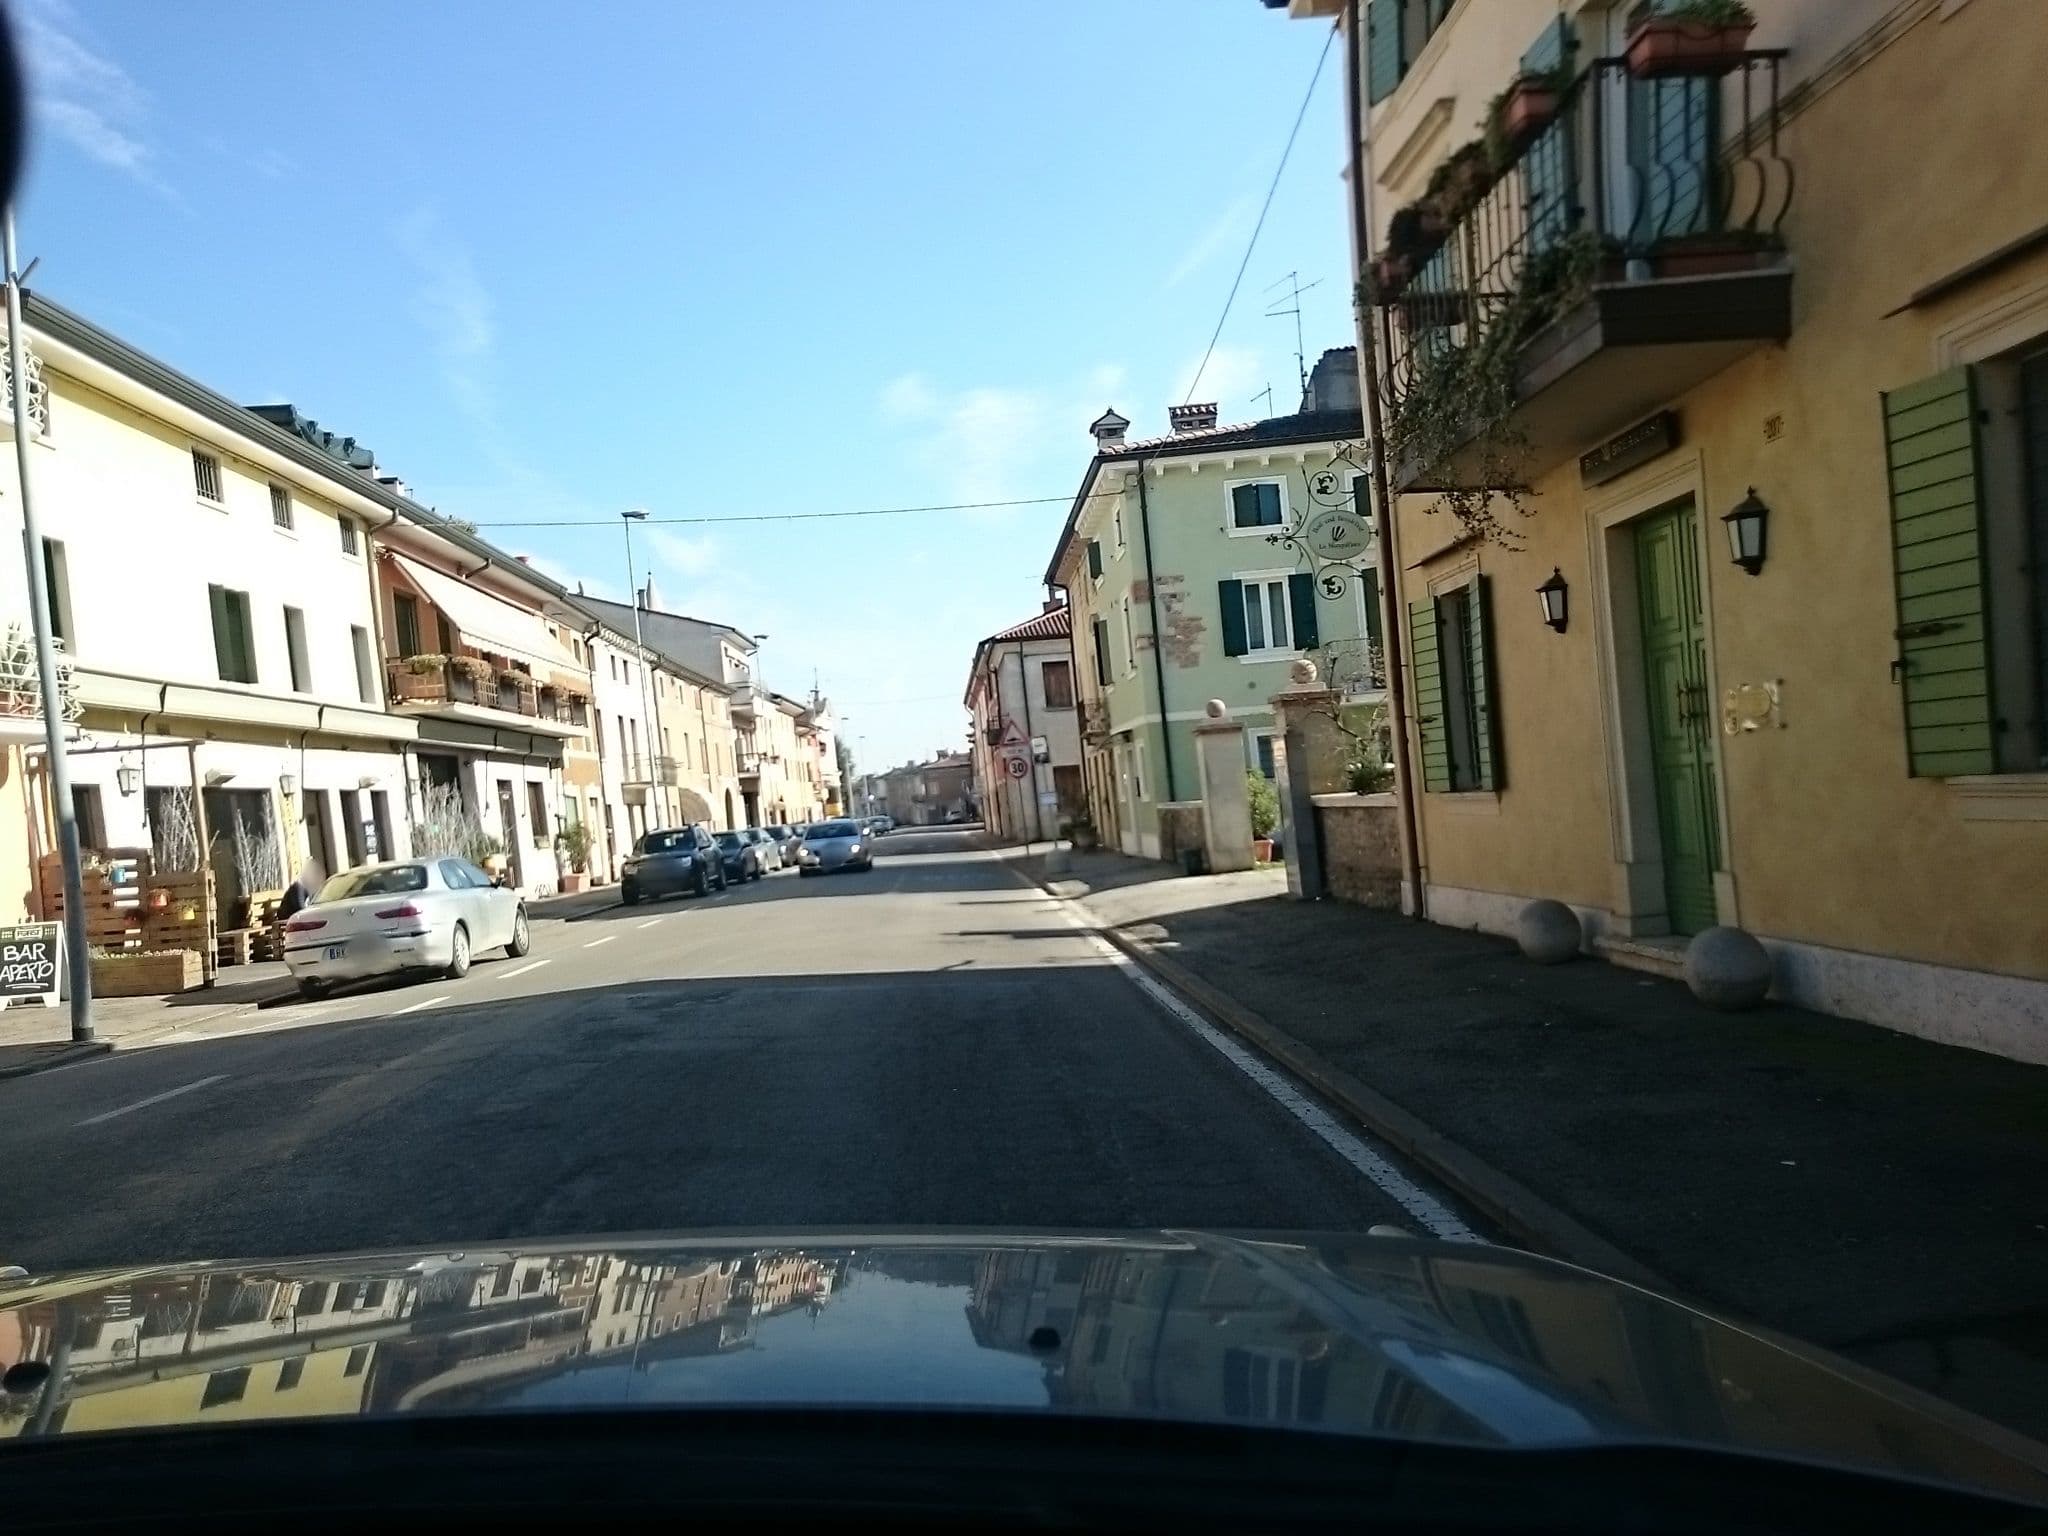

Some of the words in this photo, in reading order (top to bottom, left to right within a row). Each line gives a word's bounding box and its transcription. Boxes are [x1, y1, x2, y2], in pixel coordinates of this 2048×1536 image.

[1011, 762, 1025, 774] 30
[3, 942, 46, 962] BAR
[0, 959, 54, 983] APERTO
